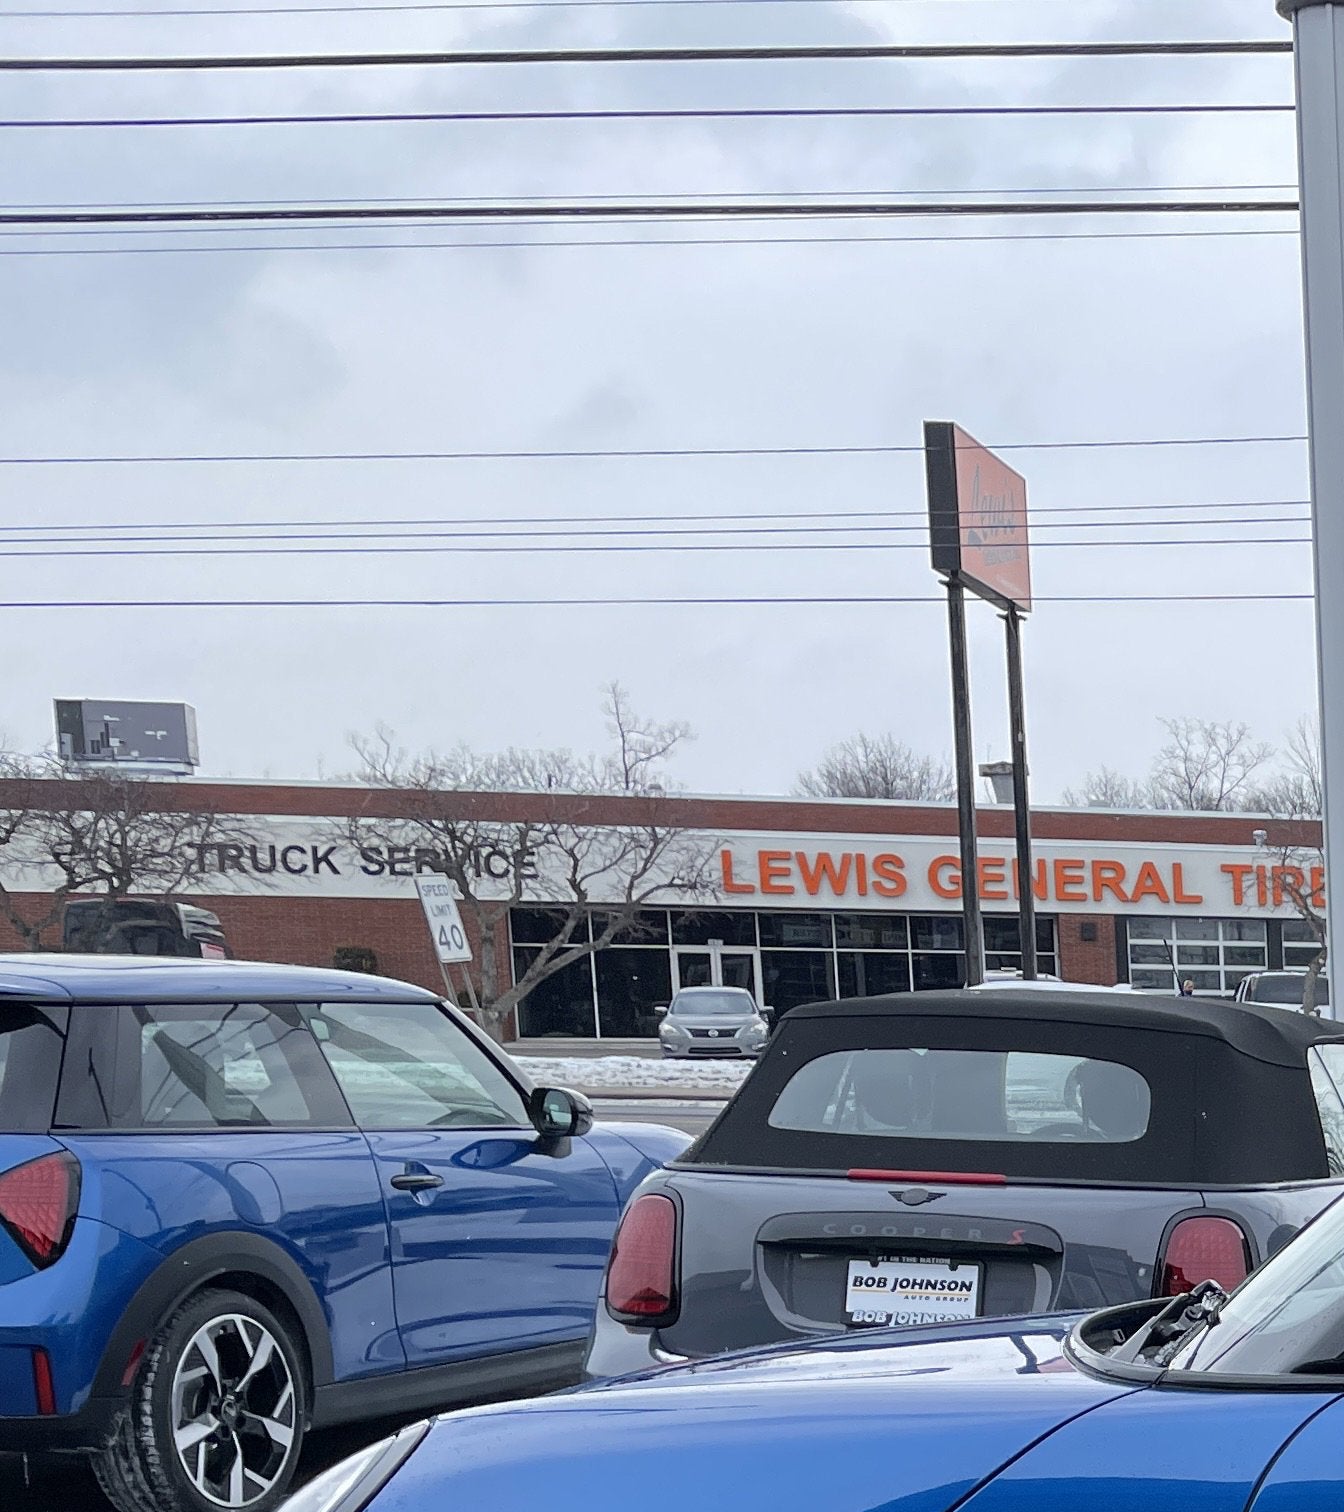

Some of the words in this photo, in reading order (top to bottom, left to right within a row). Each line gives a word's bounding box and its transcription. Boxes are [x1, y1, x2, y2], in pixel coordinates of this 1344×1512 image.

[187, 843, 341, 875] TRUCK
[361, 847, 540, 879] SERICE
[721, 849, 908, 898] LEWIS
[928, 855, 1203, 905] GENERAL
[421, 884, 449, 897] SPEED
[430, 904, 453, 918] LIMIT
[438, 924, 464, 951] 40
[823, 1223, 984, 1240] COOPER
[1006, 1228, 1026, 1246] S
[852, 1275, 888, 1289] BOB
[890, 1277, 974, 1293] JOHNSON
[936, 1296, 970, 1304] GROUP
[851, 1309, 888, 1324] BOB
